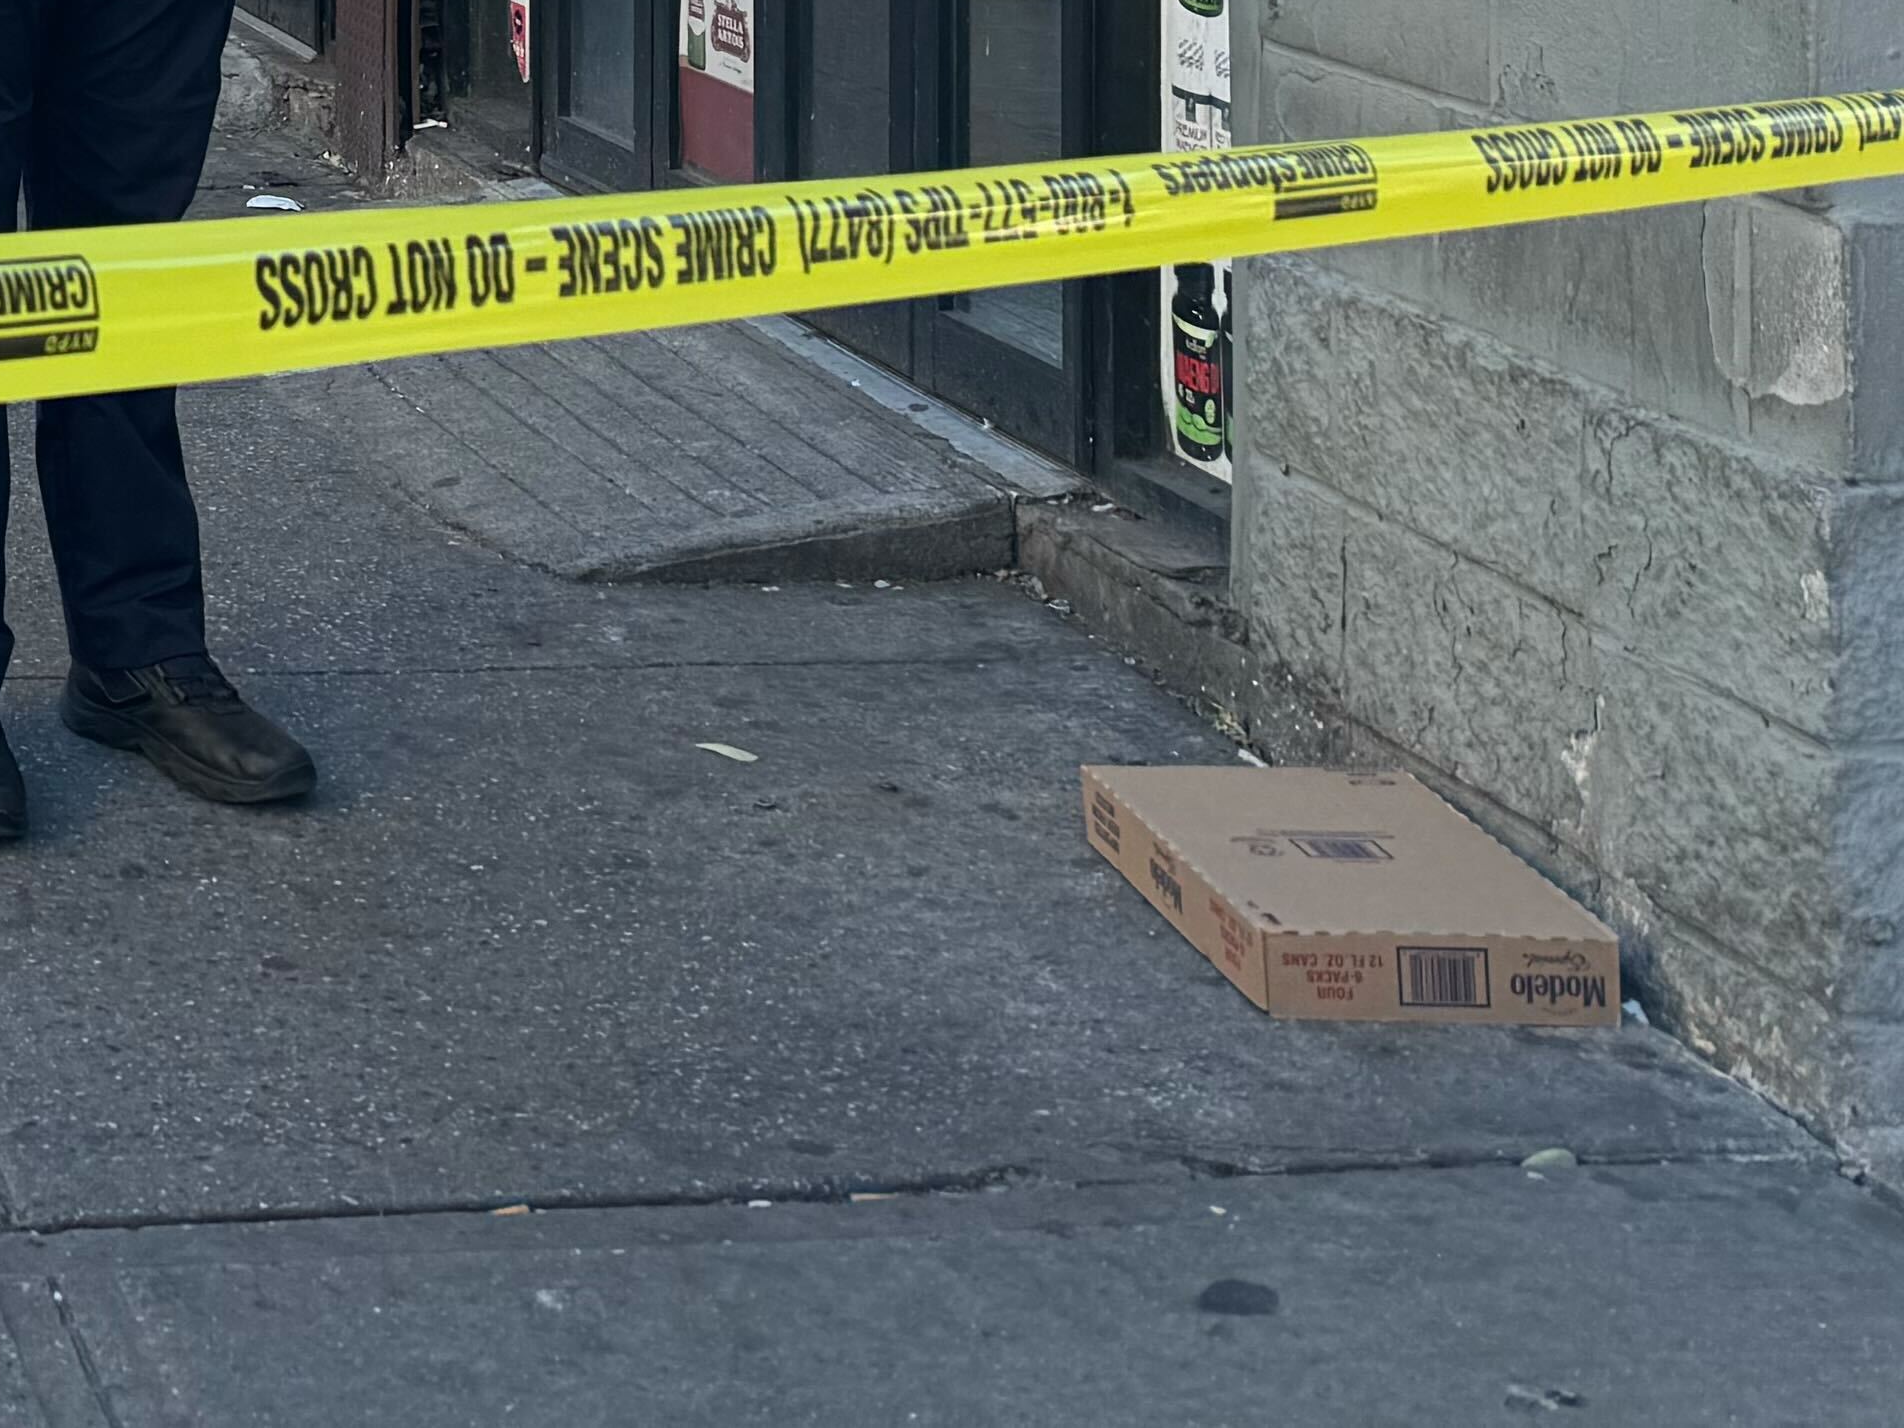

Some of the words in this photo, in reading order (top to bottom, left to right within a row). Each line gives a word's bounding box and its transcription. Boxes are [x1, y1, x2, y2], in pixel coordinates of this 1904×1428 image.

[717, 14, 744, 34] STELLA
[717, 28, 744, 49] ARTOIS
[1471, 126, 1569, 195] CROSS
[1558, 118, 1623, 184] NOT
[1614, 116, 1663, 175] DO
[1667, 107, 1766, 169] SCENE
[1753, 97, 1843, 160] CRIME
[557, 214, 665, 299] SCENE
[675, 204, 778, 286] CRIME
[792, 186, 897, 275] (8477)
[255, 246, 380, 331] CROSS
[387, 236, 456, 314] NOT
[465, 231, 515, 308] DO
[1281, 951, 1319, 967] CANS
[1509, 972, 1607, 1009] Modelo
